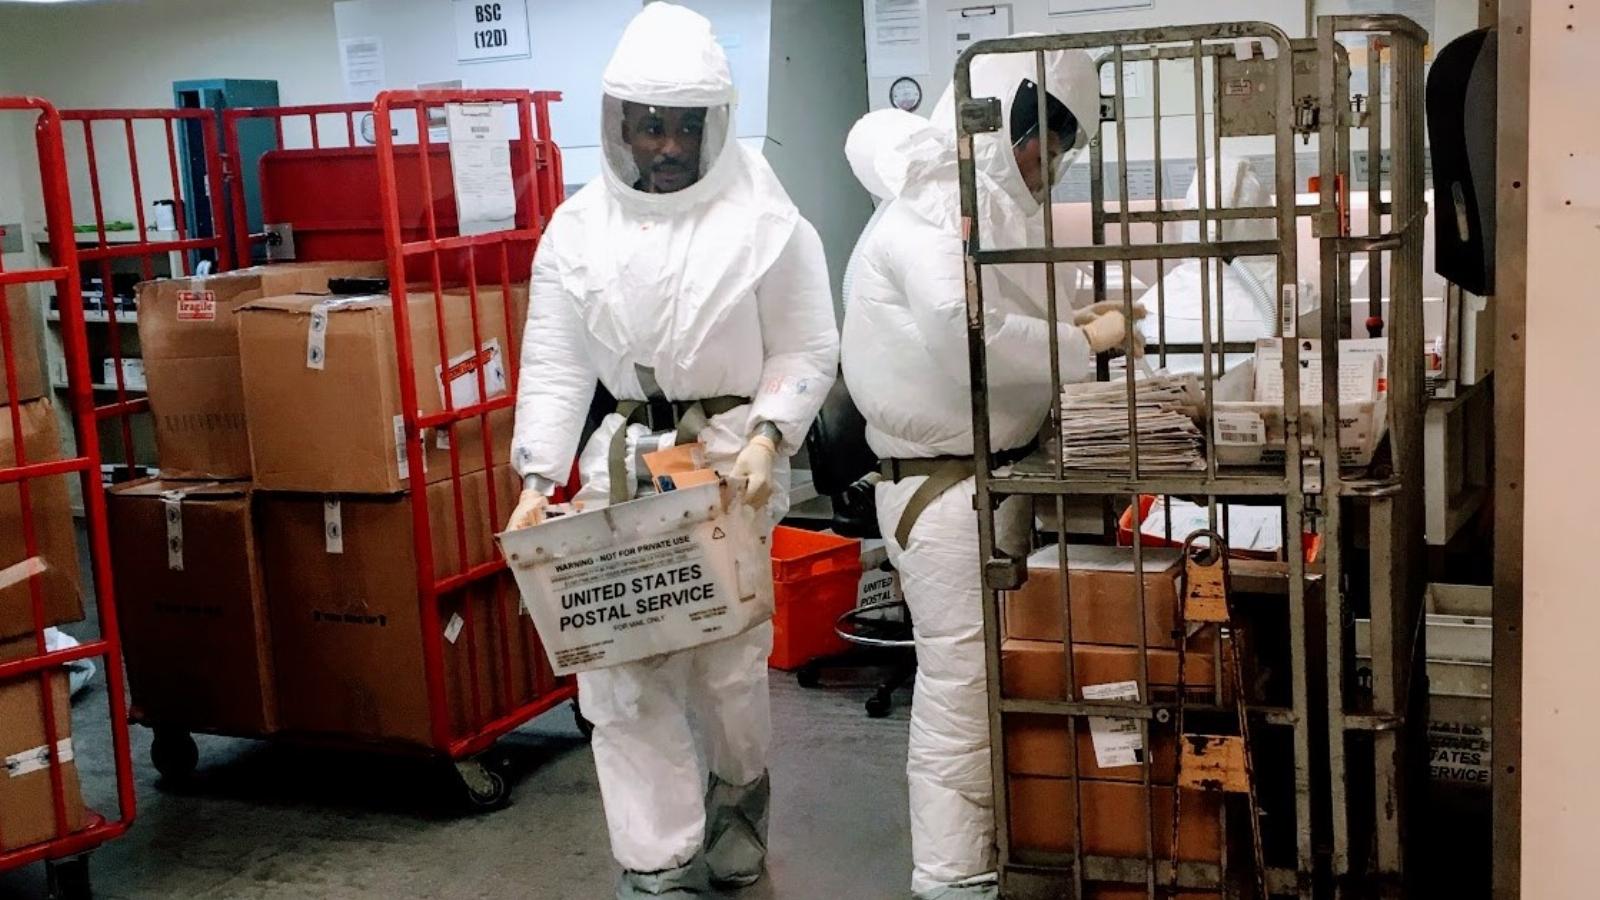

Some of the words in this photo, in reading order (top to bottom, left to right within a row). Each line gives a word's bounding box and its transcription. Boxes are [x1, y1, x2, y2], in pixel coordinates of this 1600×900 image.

[475, 3, 502, 23] BSC
[474, 28, 508, 49] (12D)
[180, 301, 213, 313] fragile
[555, 557, 594, 573] WARNING
[600, 552, 617, 562] NOT
[618, 547, 636, 557] FOR
[637, 540, 672, 553] PRIVATE
[673, 535, 690, 546] USE
[561, 582, 626, 610] UNITED
[631, 564, 702, 594] STATES
[863, 577, 893, 593] UNITED
[861, 590, 891, 606] POSTAL
[559, 604, 631, 632] POSTAL
[636, 583, 715, 614] SERVICE
[613, 622, 629, 632] FOR
[629, 619, 645, 629] MAIL
[646, 615, 665, 626] ONLY
[1430, 750, 1481, 765] TATES
[1431, 766, 1489, 783] ERVICE
